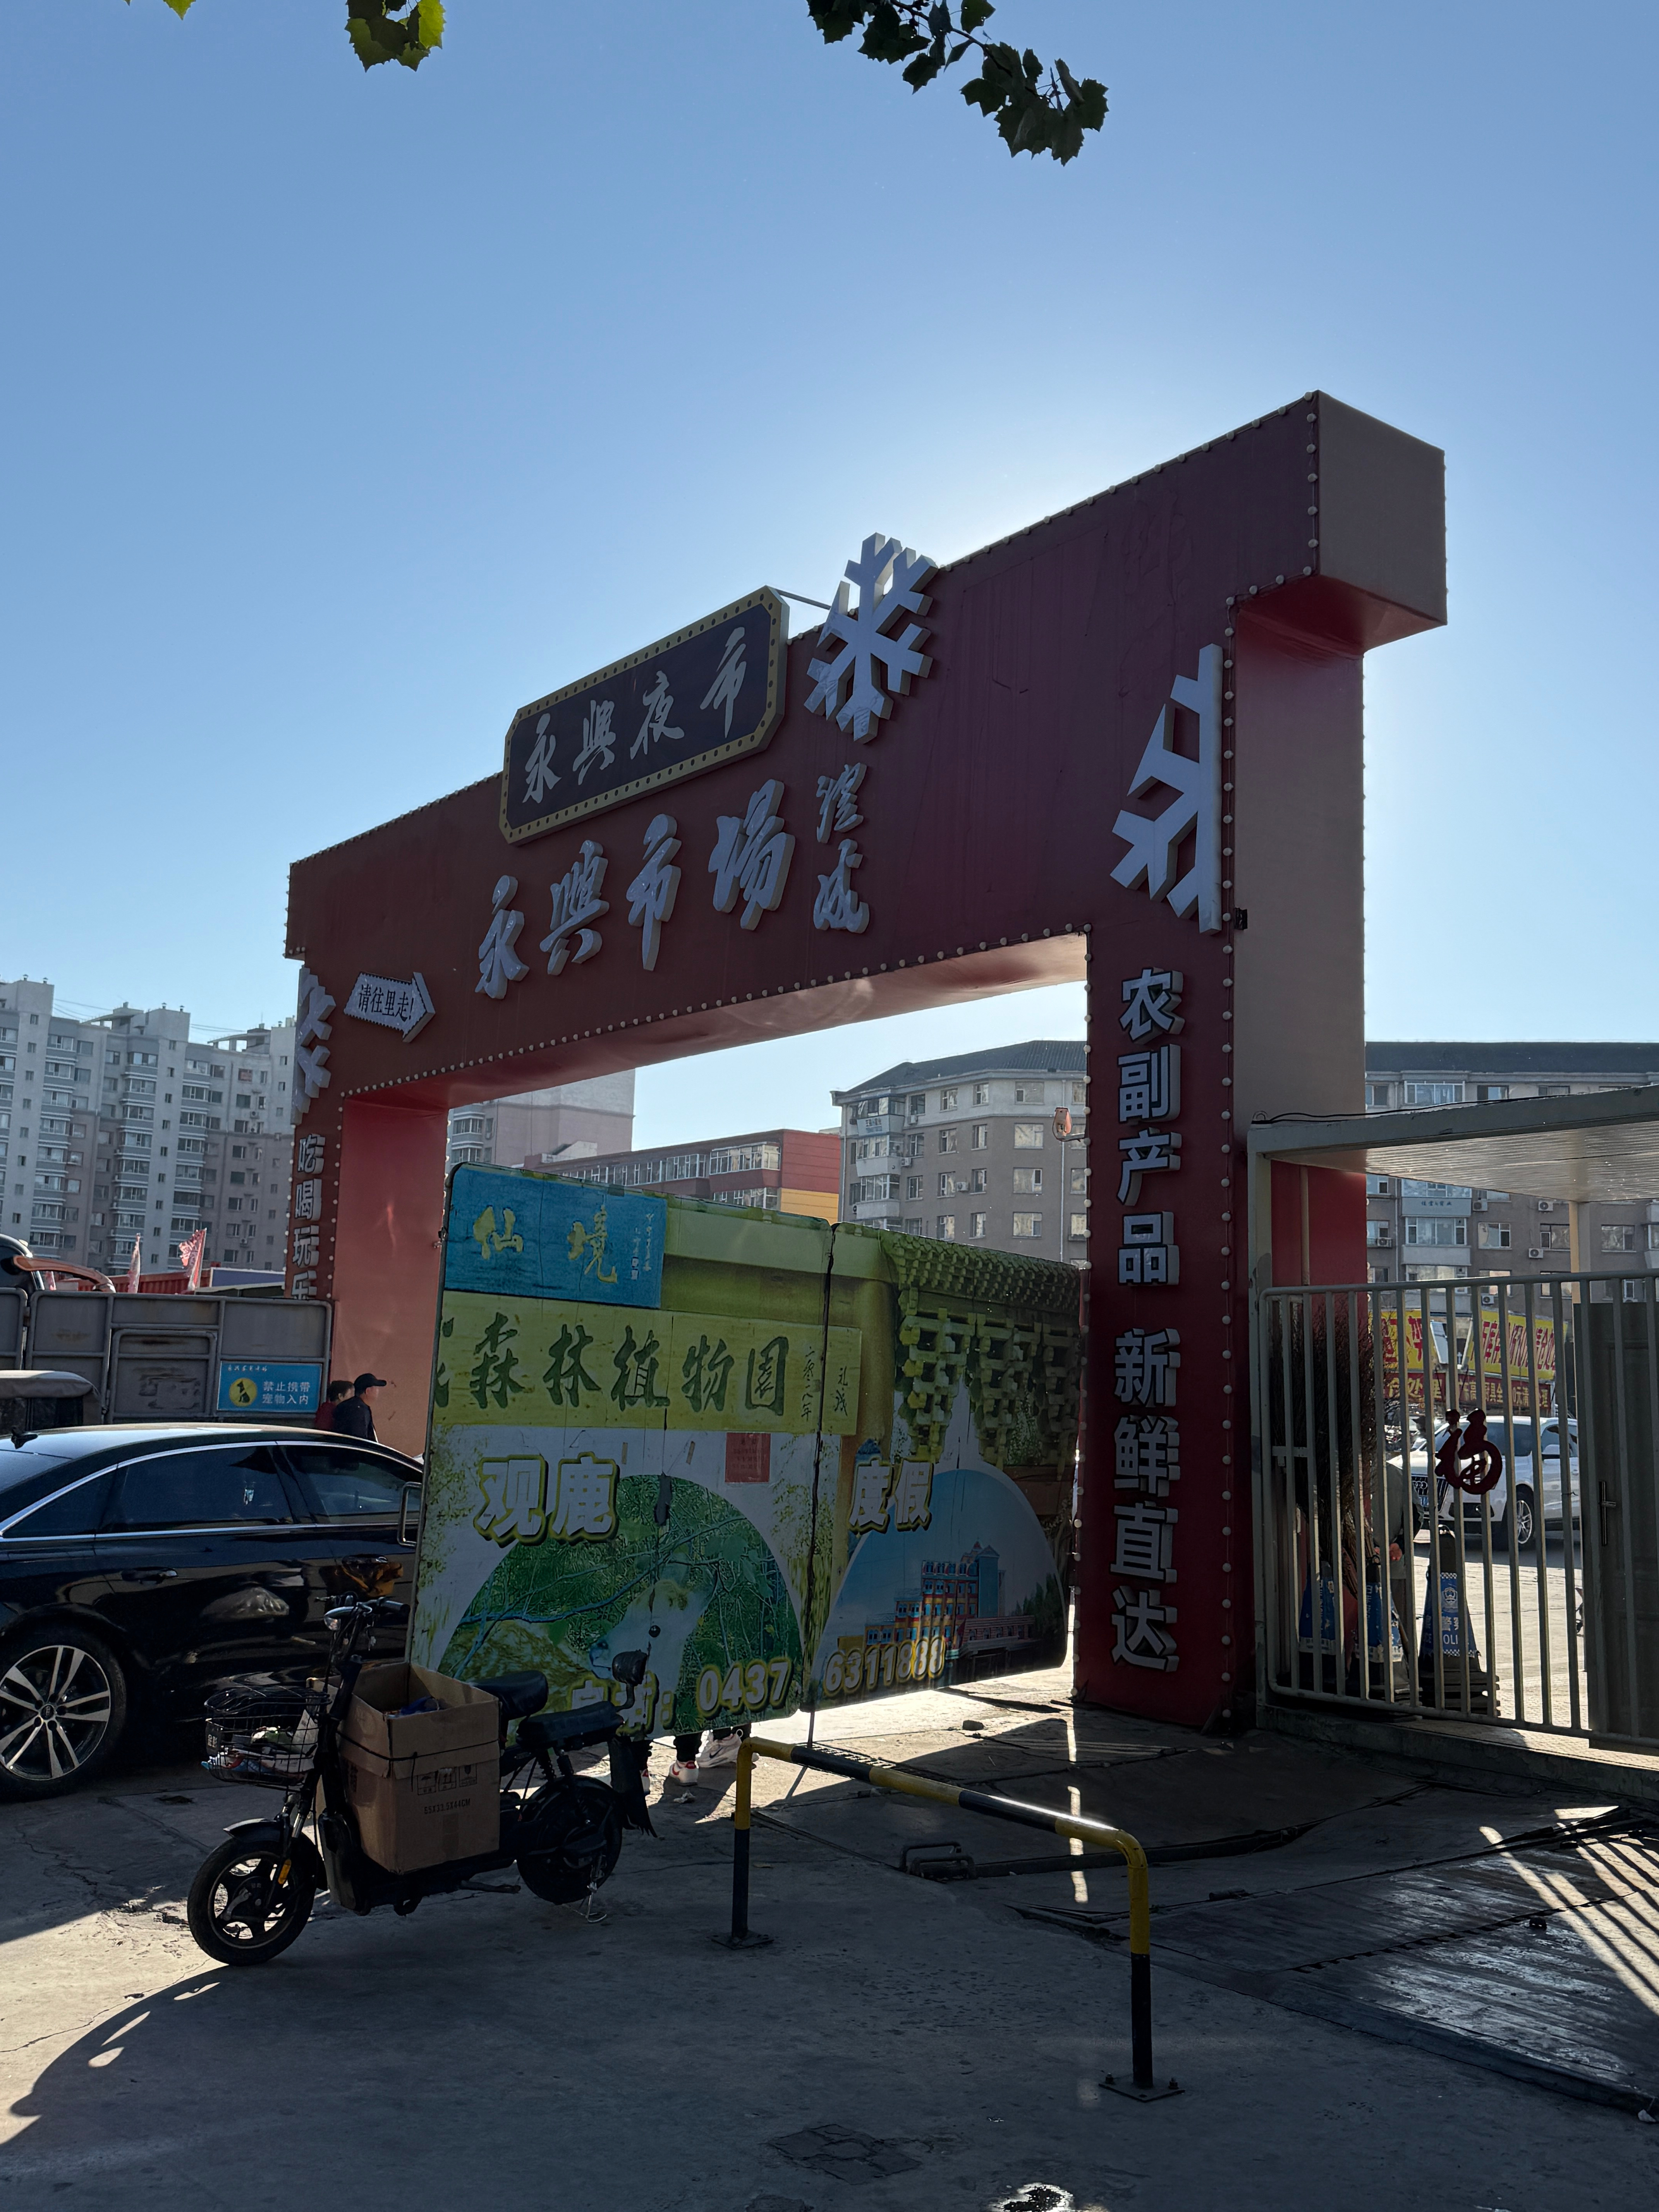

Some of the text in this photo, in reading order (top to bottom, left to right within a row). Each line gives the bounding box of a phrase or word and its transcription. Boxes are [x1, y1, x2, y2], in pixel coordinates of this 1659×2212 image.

[1109, 967, 1185, 1672] 农副产品 新鲜直达
[262, 1394, 309, 1405] 宠物入内
[263, 1381, 311, 1393] 禁止携带
[1434, 1408, 1503, 1494] 福
[475, 1453, 617, 1543] 观鹿
[848, 1458, 933, 1532] 度假
[699, 1658, 792, 1717] 0437
[824, 1637, 945, 1695] 6311888
